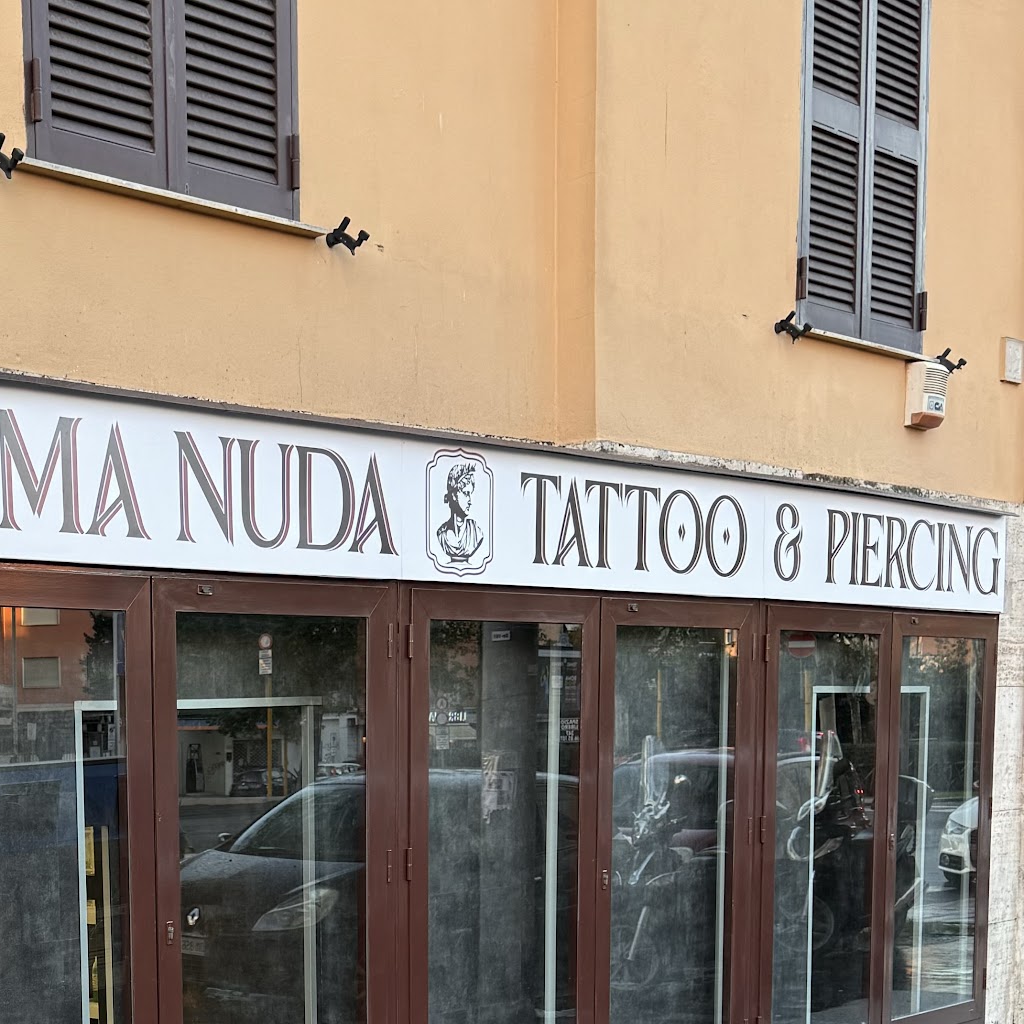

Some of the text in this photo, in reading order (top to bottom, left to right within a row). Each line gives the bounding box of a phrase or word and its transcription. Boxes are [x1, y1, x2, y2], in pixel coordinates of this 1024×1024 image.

[173, 430, 399, 557] NUDA
[520, 471, 1000, 596] TATTOO & PIERCING
